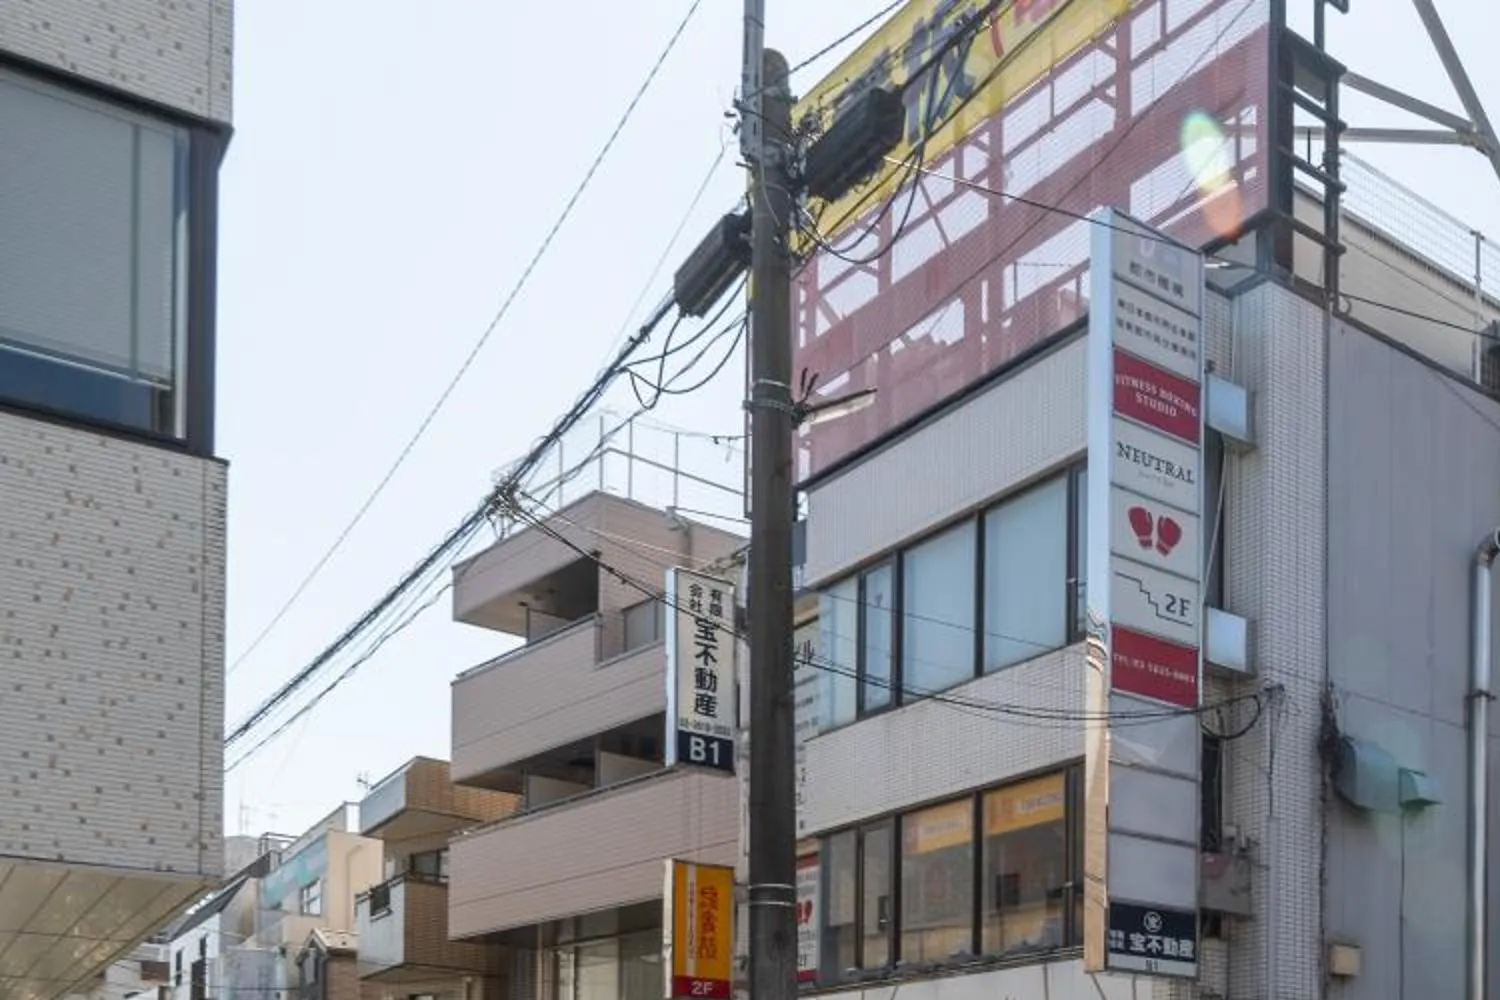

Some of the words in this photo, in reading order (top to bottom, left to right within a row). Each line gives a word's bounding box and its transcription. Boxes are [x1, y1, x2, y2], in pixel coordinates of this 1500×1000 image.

[1114, 374, 1157, 395] FITNESS
[1135, 391, 1178, 418] STUDIO
[1116, 441, 1195, 484] NEUTRAL
[1165, 593, 1192, 617] 2F
[689, 736, 720, 766] B1
[691, 980, 714, 996] 2F
